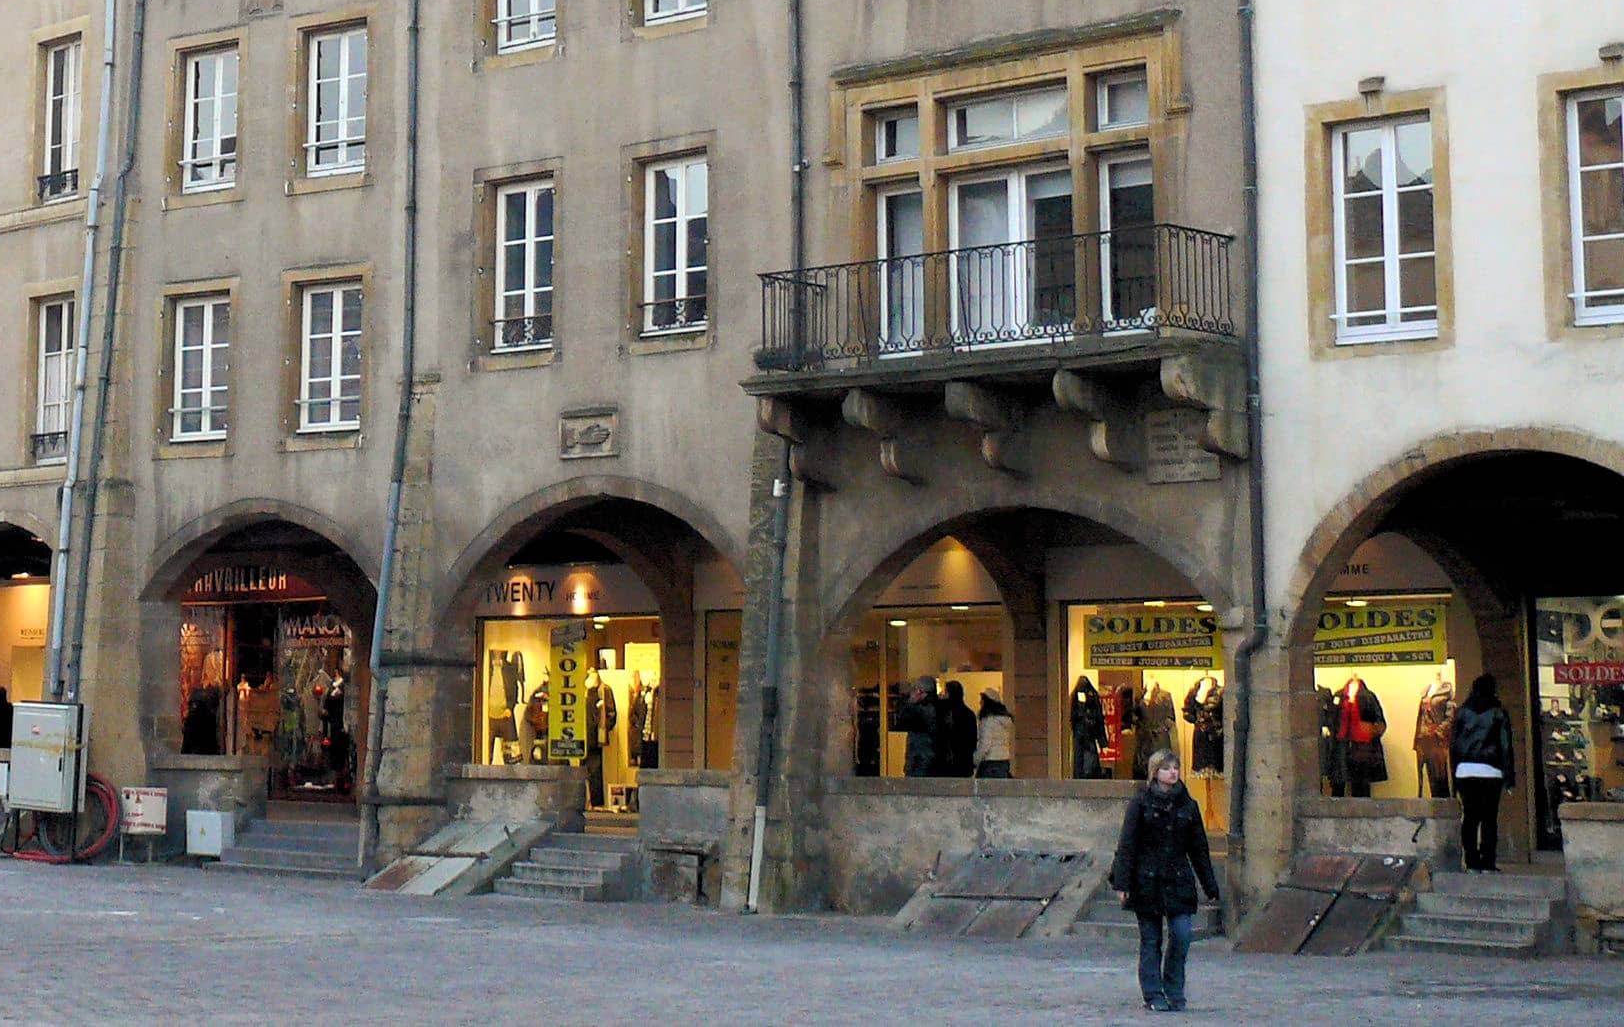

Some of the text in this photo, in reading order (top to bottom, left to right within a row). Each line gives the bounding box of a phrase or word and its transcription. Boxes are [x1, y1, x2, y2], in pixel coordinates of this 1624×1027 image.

[483, 579, 600, 604] TWENTY HOME
[1088, 616, 1216, 634] SOLDES
[1317, 608, 1437, 630] OLDES
[1314, 654, 1346, 665] MISES
[1559, 666, 1624, 682] SOLDE
[559, 642, 577, 742] SOLDES
